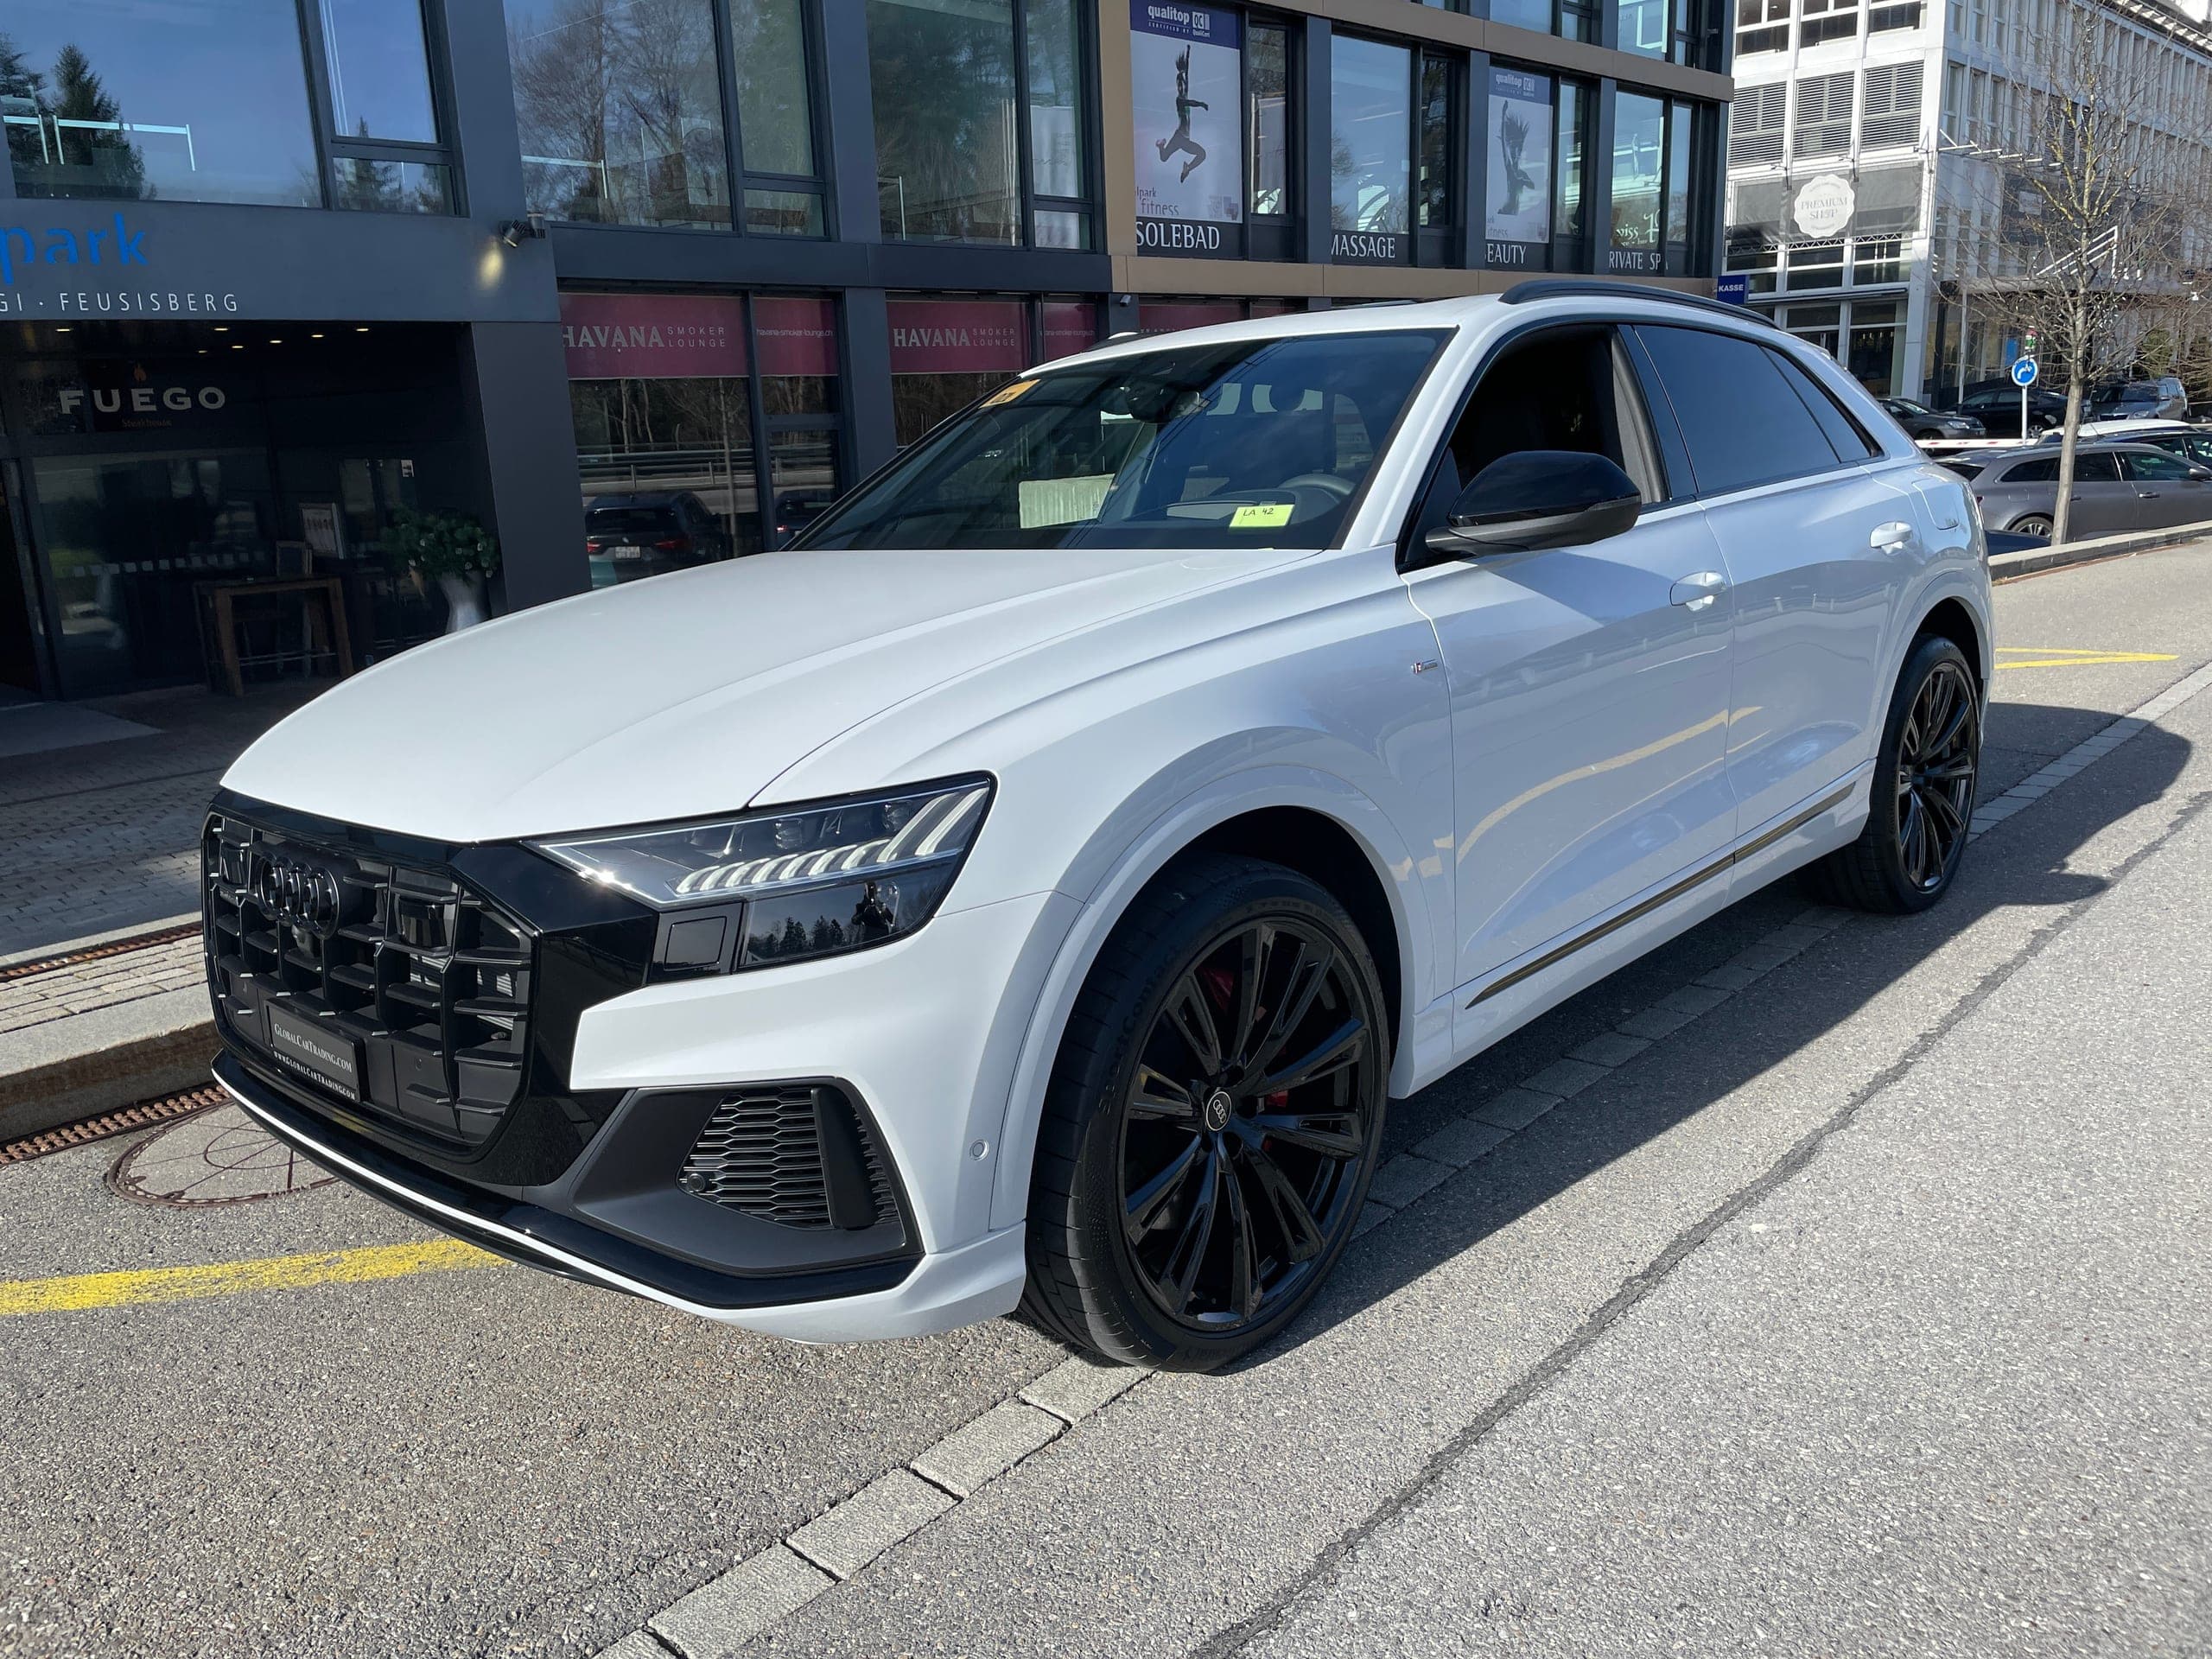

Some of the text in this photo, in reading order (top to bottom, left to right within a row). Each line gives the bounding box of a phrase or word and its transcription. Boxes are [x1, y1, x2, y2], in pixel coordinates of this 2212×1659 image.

[1147, 5, 1190, 25] qualitop
[1141, 198, 1179, 216] fitness
[1801, 196, 1847, 210] PREMIUM
[0, 213, 149, 285] park
[1485, 243, 1527, 264] EAUTY
[1718, 283, 1744, 292] KASSE
[60, 293, 238, 312] FEUSISBERG
[563, 326, 664, 347] HAVANA
[667, 327, 725, 335] SMOKER
[893, 328, 970, 346] HAVANA
[669, 339, 726, 347] LOUNGE
[973, 338, 1015, 346] LOUNGE
[59, 387, 226, 415] FUEGO
